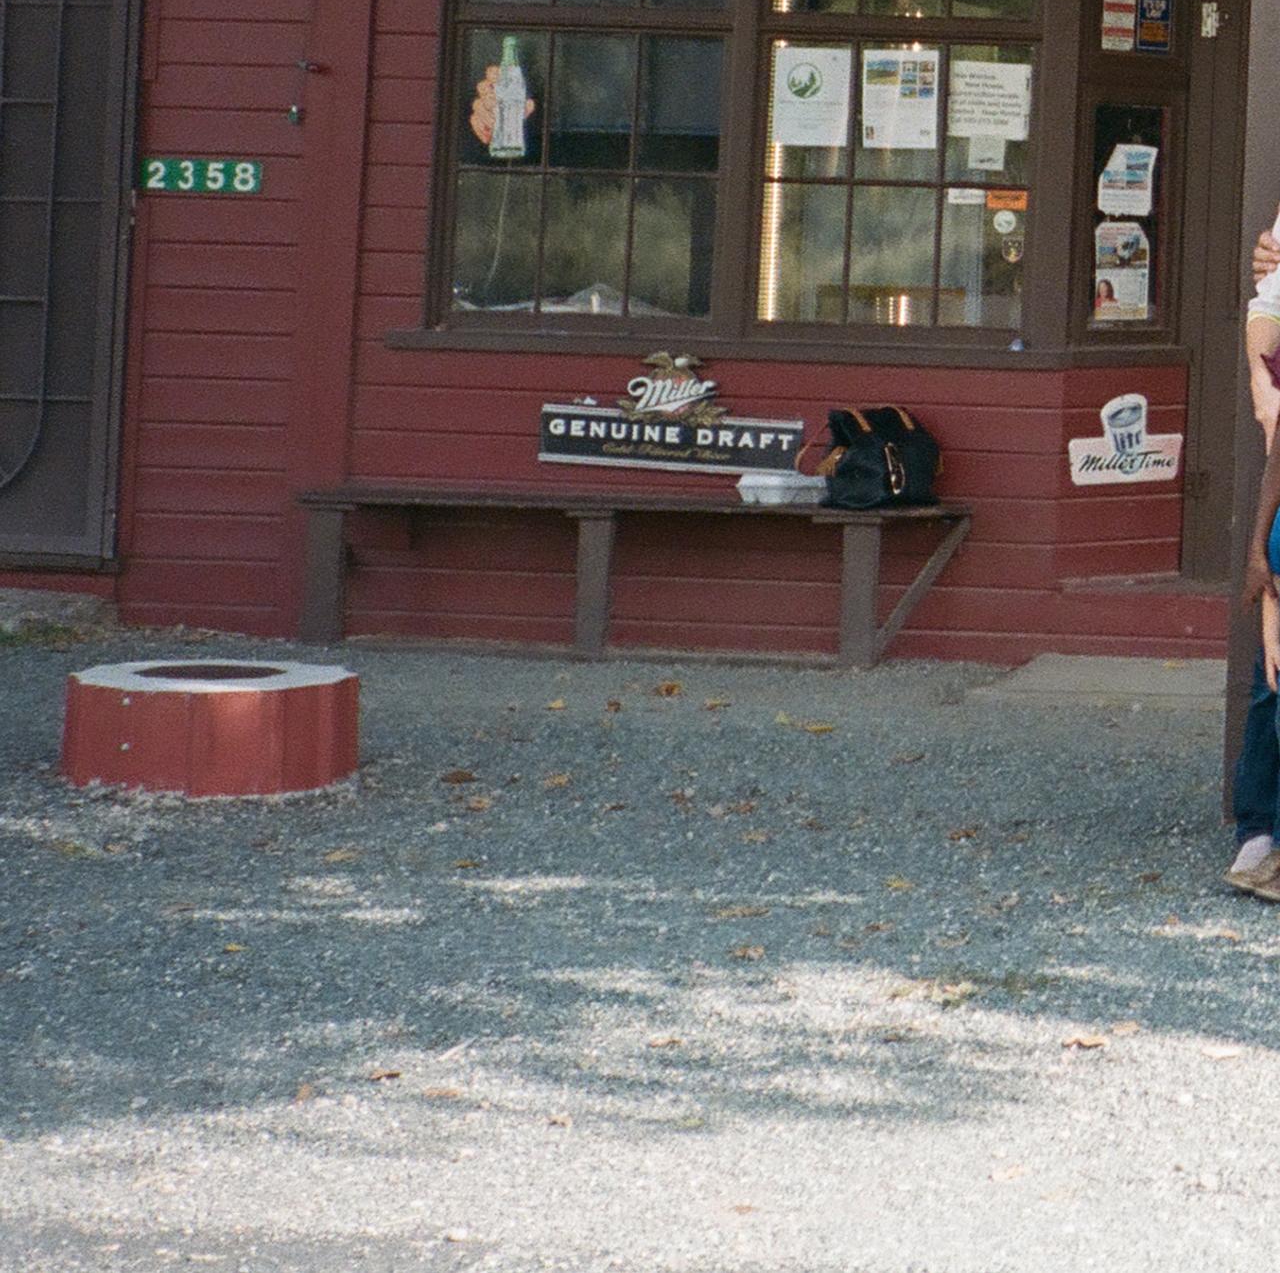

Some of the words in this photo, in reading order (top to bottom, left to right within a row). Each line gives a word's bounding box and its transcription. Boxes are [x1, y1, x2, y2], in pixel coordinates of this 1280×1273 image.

[147, 160, 256, 191] 2358
[627, 376, 720, 413] Miller
[549, 418, 682, 444] GENUINE
[696, 428, 795, 452] DRAFT
[1078, 453, 1136, 473] Miller
[1136, 450, 1176, 469] Time
